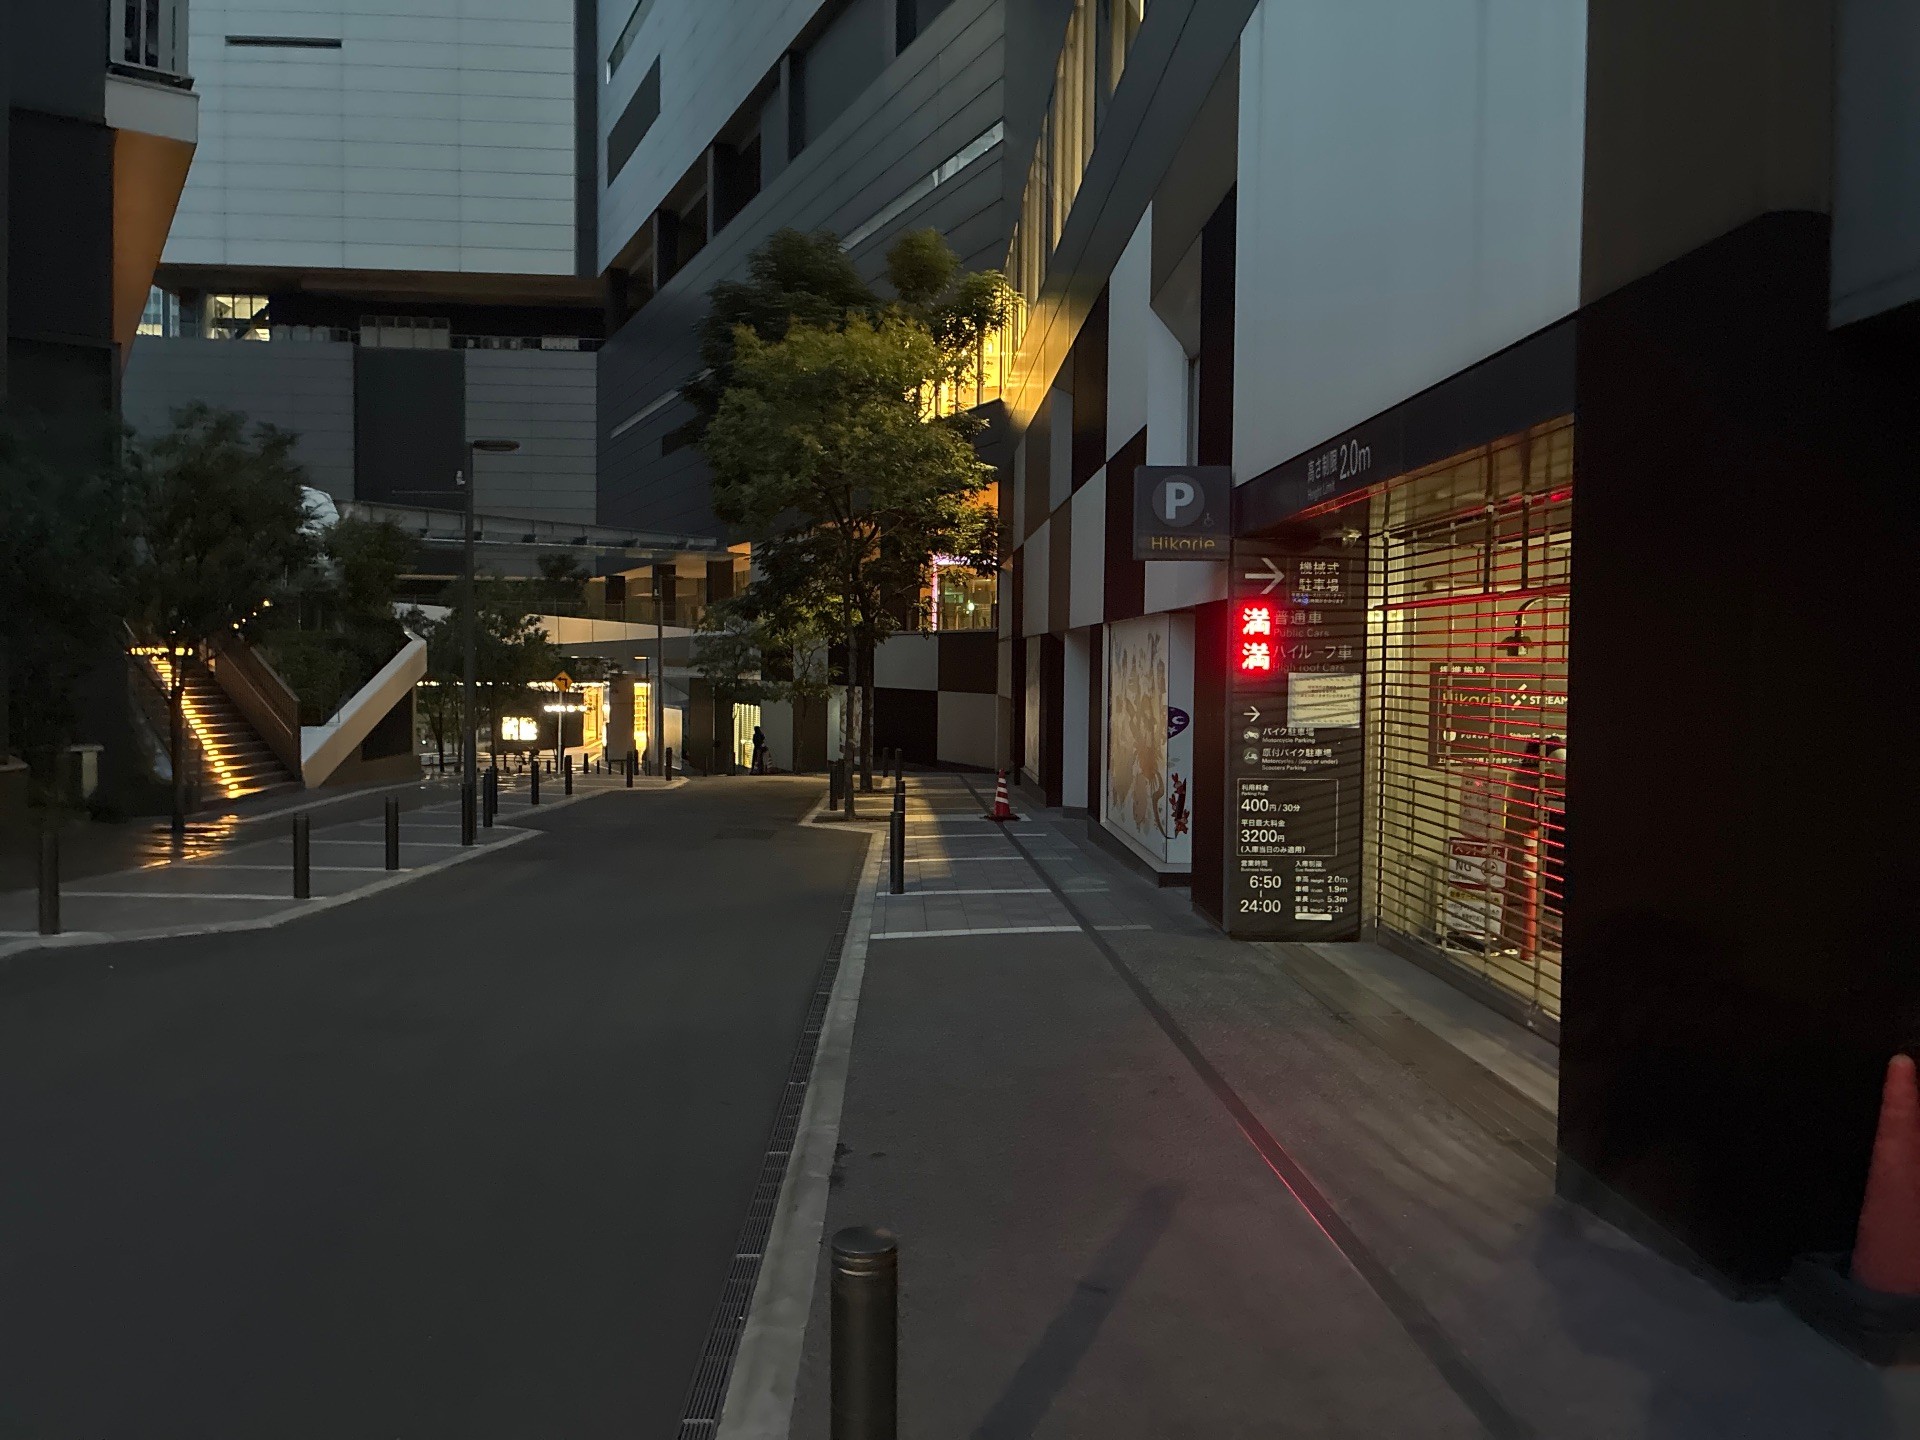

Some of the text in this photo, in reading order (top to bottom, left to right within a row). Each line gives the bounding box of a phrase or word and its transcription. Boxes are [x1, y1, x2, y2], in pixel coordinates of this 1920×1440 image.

[1340, 439, 1371, 480] 2.0m
[1166, 482, 1195, 520] P
[1152, 536, 1215, 551] Hikarie
[1299, 561, 1340, 575] 機械式
[1299, 578, 1340, 592] 駐車場
[1242, 607, 1271, 636] 満
[1275, 610, 1323, 625] 普通車
[1274, 629, 1330, 638] Public Cars
[1242, 641, 1271, 671] 満
[1273, 645, 1353, 660] ハイルーフ車
[1262, 727, 1315, 737] バイク駐車場
[1262, 748, 1332, 758] 原付バイク駐車場
[1241, 819, 1286, 827] 平日最大料金
[1241, 829, 1285, 843] 3200円
[1249, 875, 1281, 888] 6:50
[1327, 875, 1348, 883] 2.0m
[1328, 885, 1348, 893] 1.9m
[1240, 899, 1281, 913] 24:00
[1327, 895, 1348, 903] 5.3m
[1327, 905, 1344, 913] 2.3t
